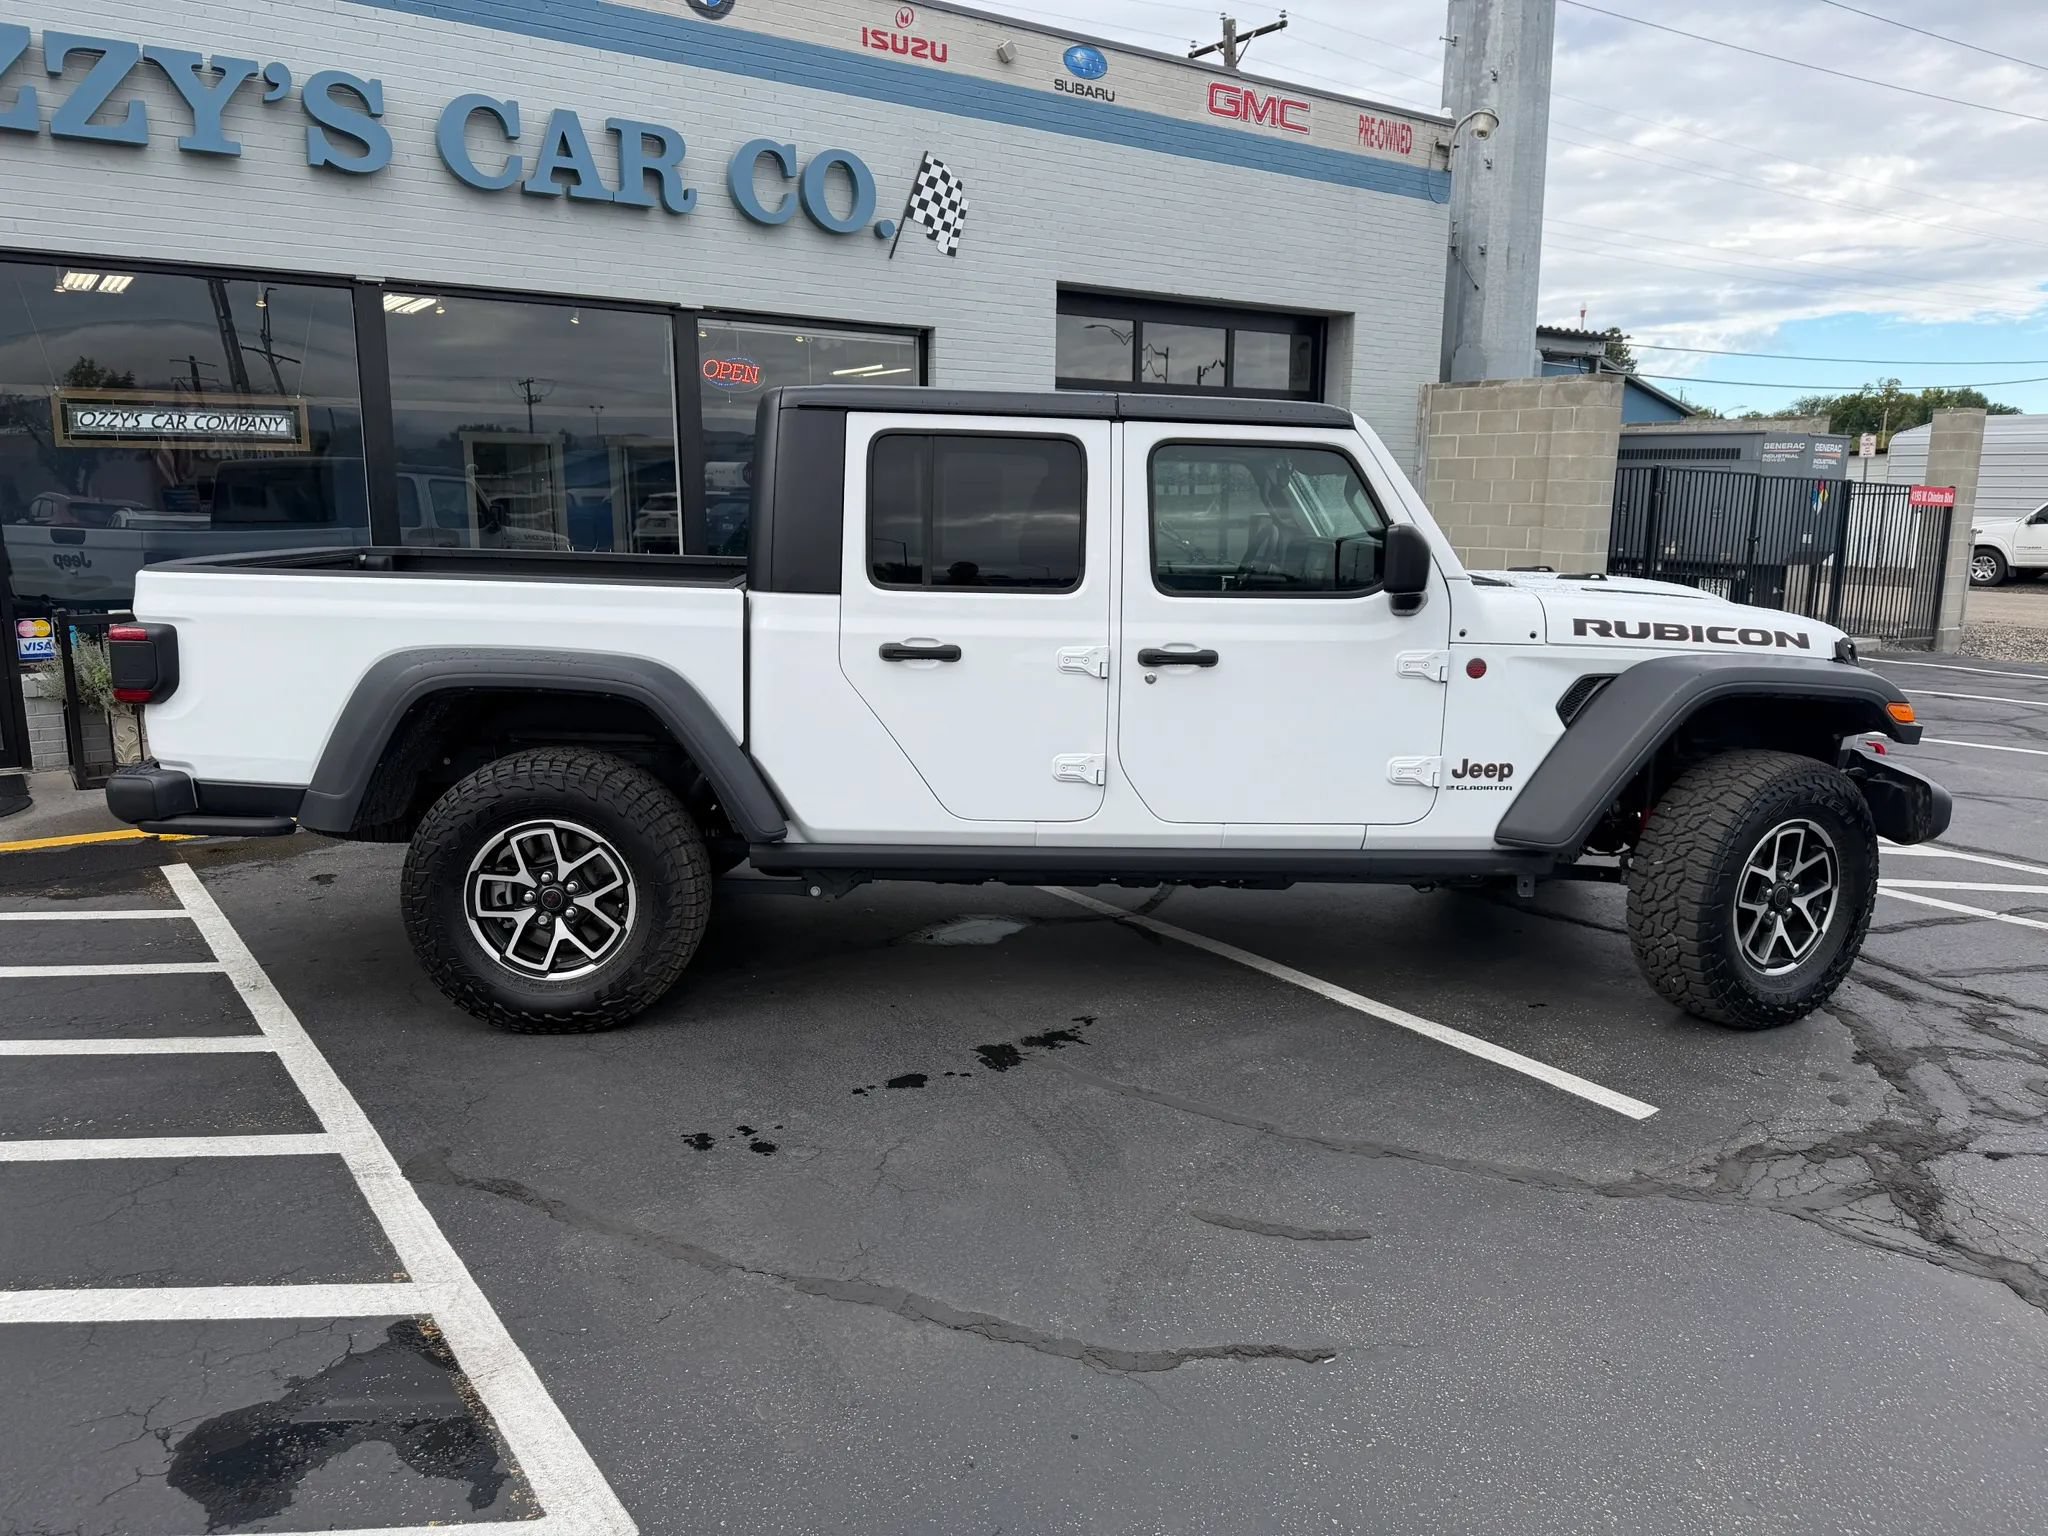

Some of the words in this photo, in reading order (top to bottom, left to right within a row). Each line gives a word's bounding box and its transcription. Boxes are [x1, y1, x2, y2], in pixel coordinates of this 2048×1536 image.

[862, 26, 948, 63] ISUZU
[1054, 79, 1115, 102] SUBARU
[1207, 80, 1310, 135] GMC
[1358, 114, 1413, 154] PRE-OWNED
[435, 92, 698, 215] CAR
[728, 138, 896, 240] CO.
[703, 359, 760, 384] OPEN
[79, 411, 142, 428] OZZY'S
[151, 413, 188, 430] CAR
[194, 414, 287, 432] COMPANY
[1763, 442, 1805, 450] GENERAC
[1814, 443, 1843, 452] GENERAC
[24, 641, 53, 651] VISA
[1572, 618, 1811, 650] RUBICON
[1451, 758, 1514, 782] Jeep
